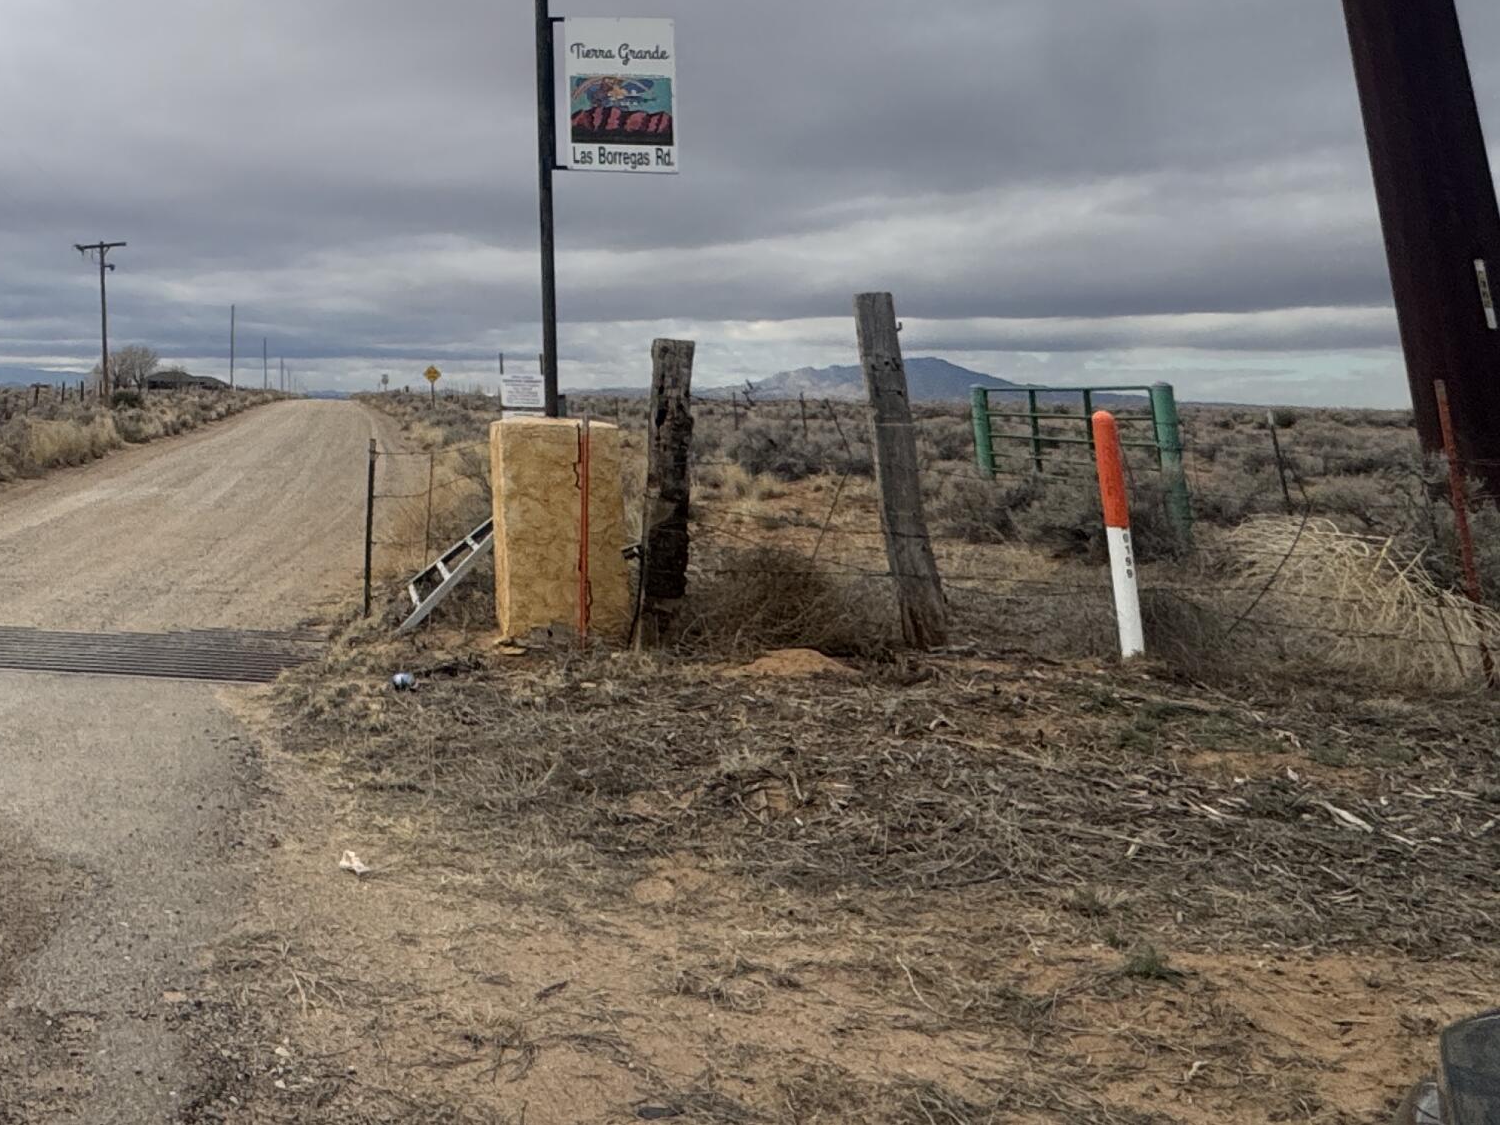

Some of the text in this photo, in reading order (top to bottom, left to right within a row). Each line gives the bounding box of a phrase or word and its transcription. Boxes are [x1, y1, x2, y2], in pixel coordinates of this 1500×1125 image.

[570, 42, 670, 66] Tierra Grande
[572, 146, 675, 170] Las Borregas Rd.
